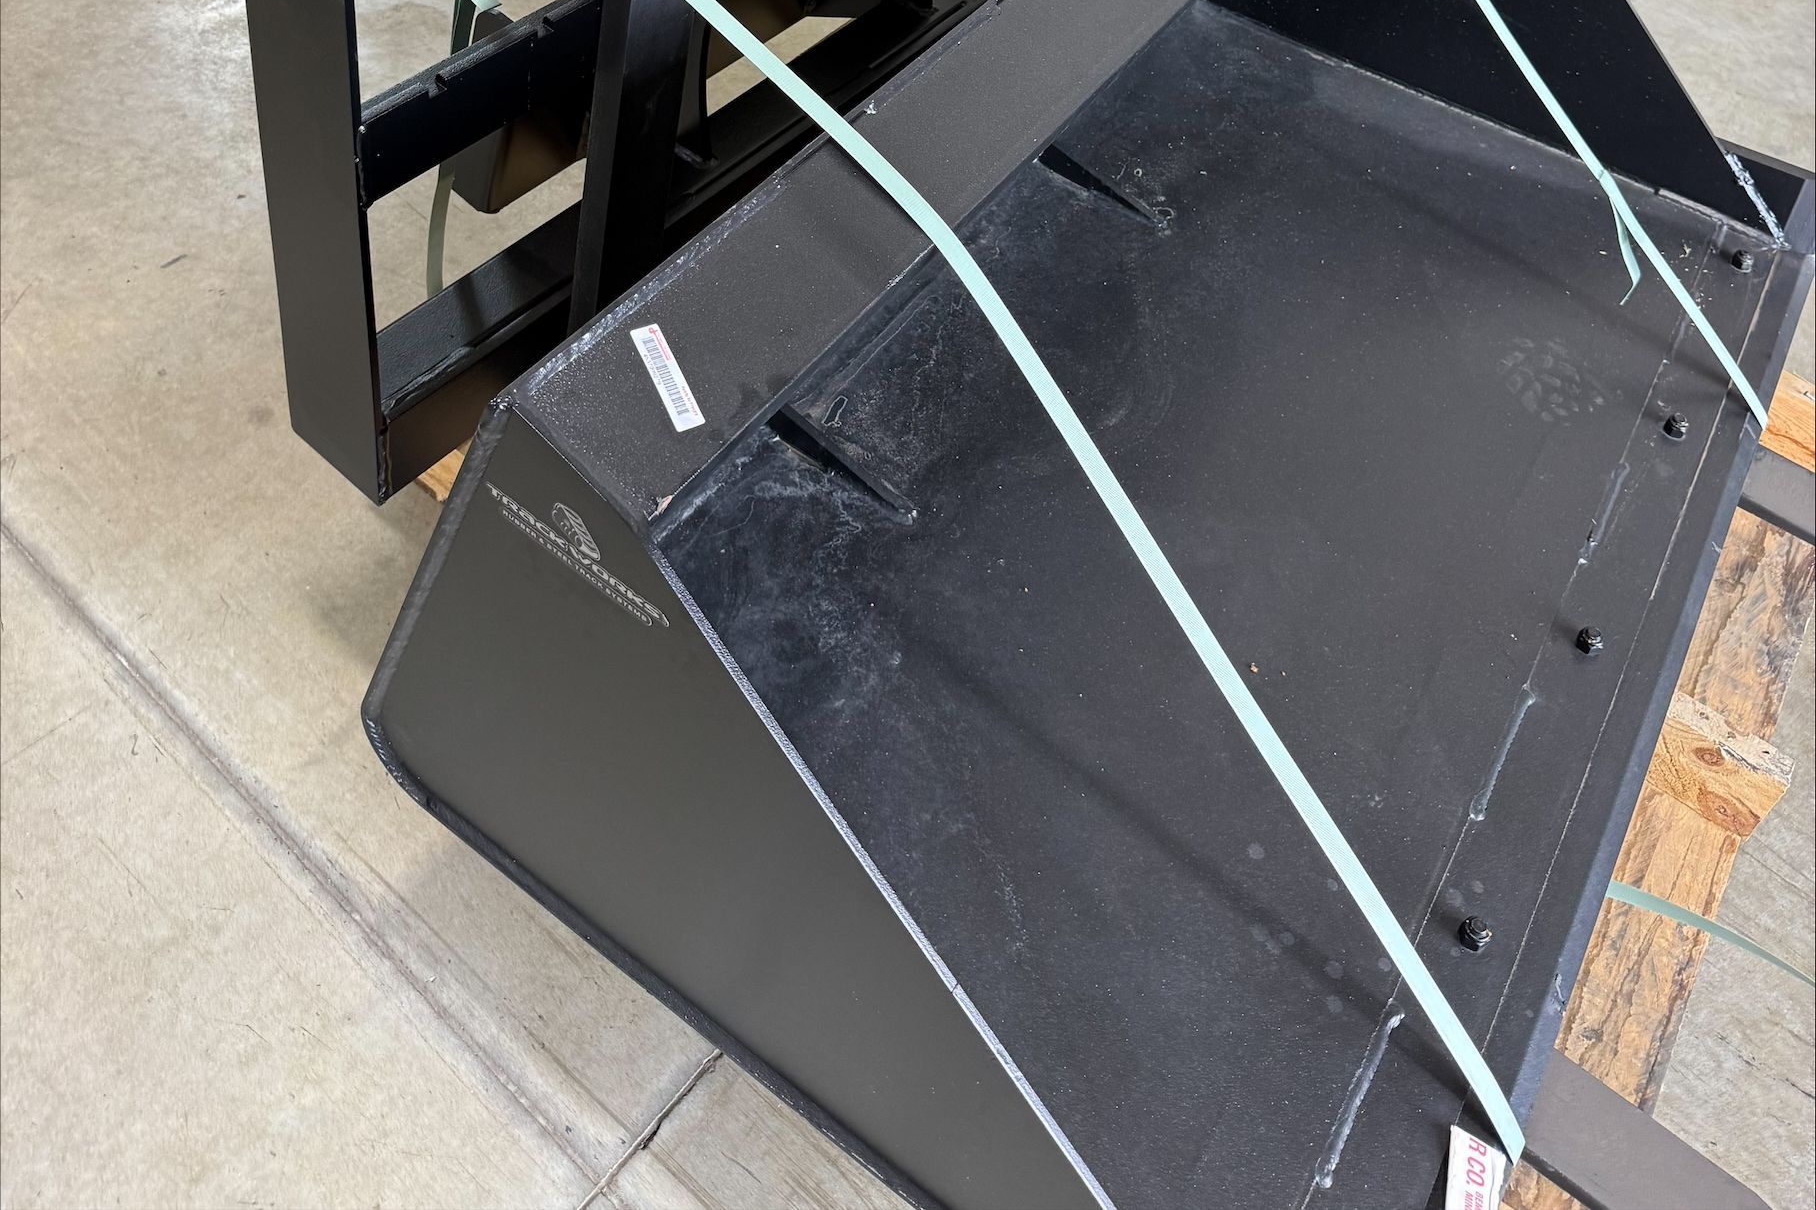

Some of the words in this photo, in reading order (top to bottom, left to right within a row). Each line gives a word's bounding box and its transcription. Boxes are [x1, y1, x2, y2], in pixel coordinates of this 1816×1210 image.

[502, 509, 537, 538] RUBBER
[546, 543, 573, 566] STEEL
[574, 563, 604, 589] TRACK
[605, 588, 648, 622] SYSTEMS
[1466, 1156, 1486, 1187] CO.
